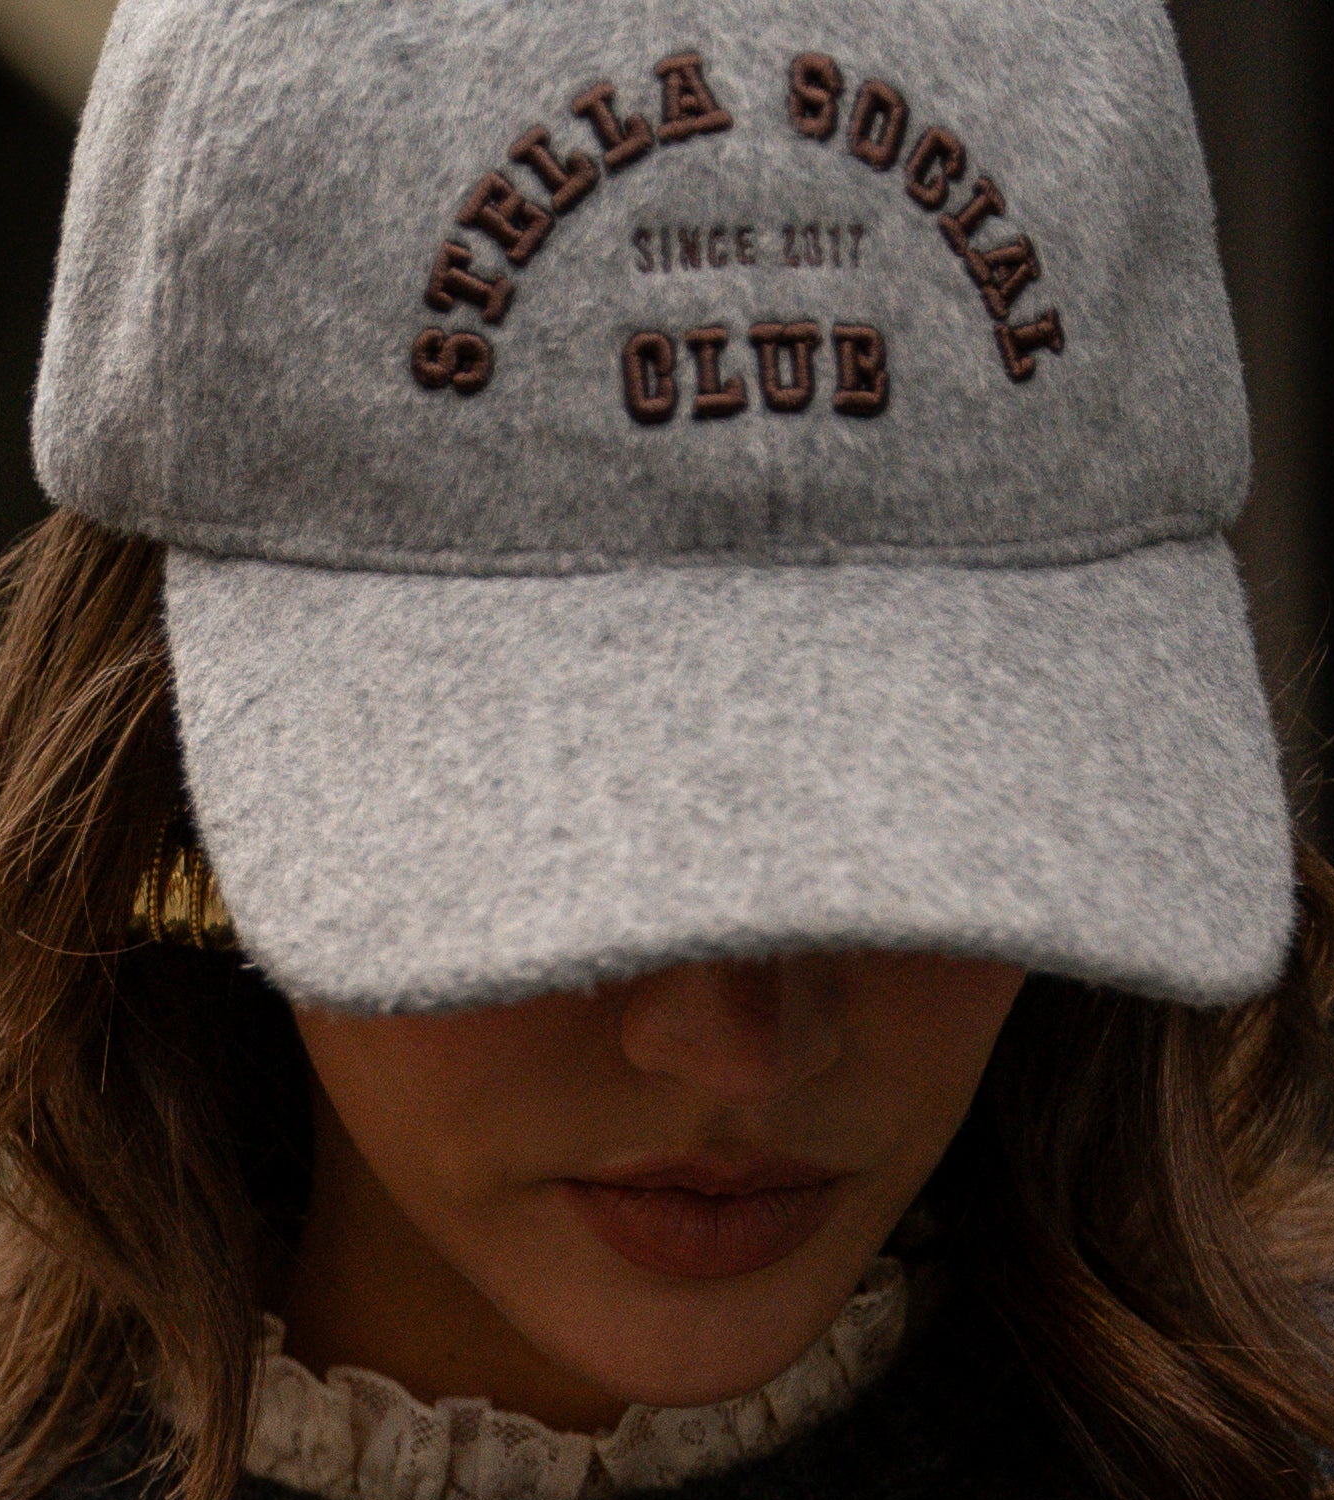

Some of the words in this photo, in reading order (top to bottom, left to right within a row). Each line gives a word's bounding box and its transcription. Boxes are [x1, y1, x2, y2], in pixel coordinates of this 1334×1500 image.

[410, 50, 734, 395] STELLA
[787, 51, 1065, 384] SOCIAL
[632, 225, 756, 273] SINCE
[781, 223, 868, 269] 2017
[622, 321, 890, 425] CLUB
